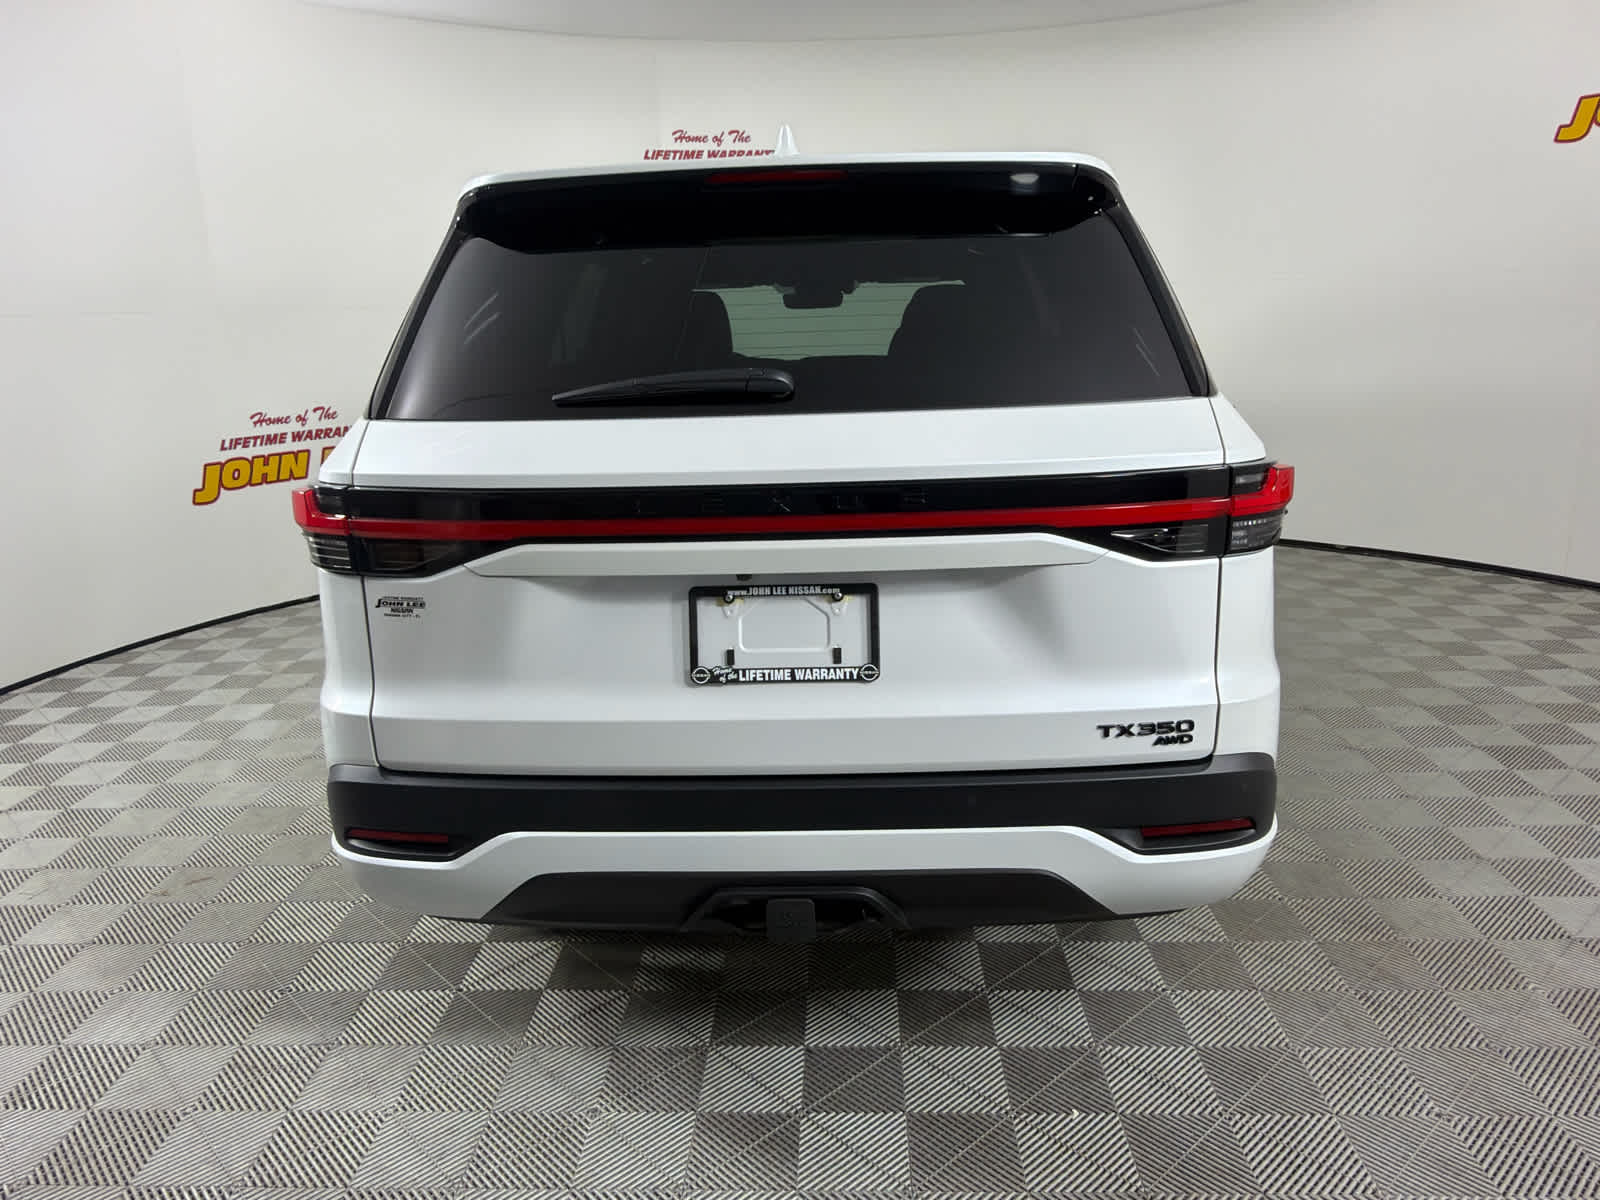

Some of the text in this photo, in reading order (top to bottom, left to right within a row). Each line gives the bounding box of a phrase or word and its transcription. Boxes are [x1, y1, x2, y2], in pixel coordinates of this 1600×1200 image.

[671, 129, 751, 147] Home of The
[643, 149, 775, 160] LIFETIME WARRANT
[250, 406, 338, 427] Home of The
[220, 432, 288, 451] LIFETIME
[192, 449, 311, 506] JOHN
[772, 586, 788, 595] LEE
[738, 669, 796, 682] LIFETIME
[796, 667, 860, 681] WARRANTY
[1096, 719, 1195, 739] TX350
[1151, 733, 1194, 747] AWD
